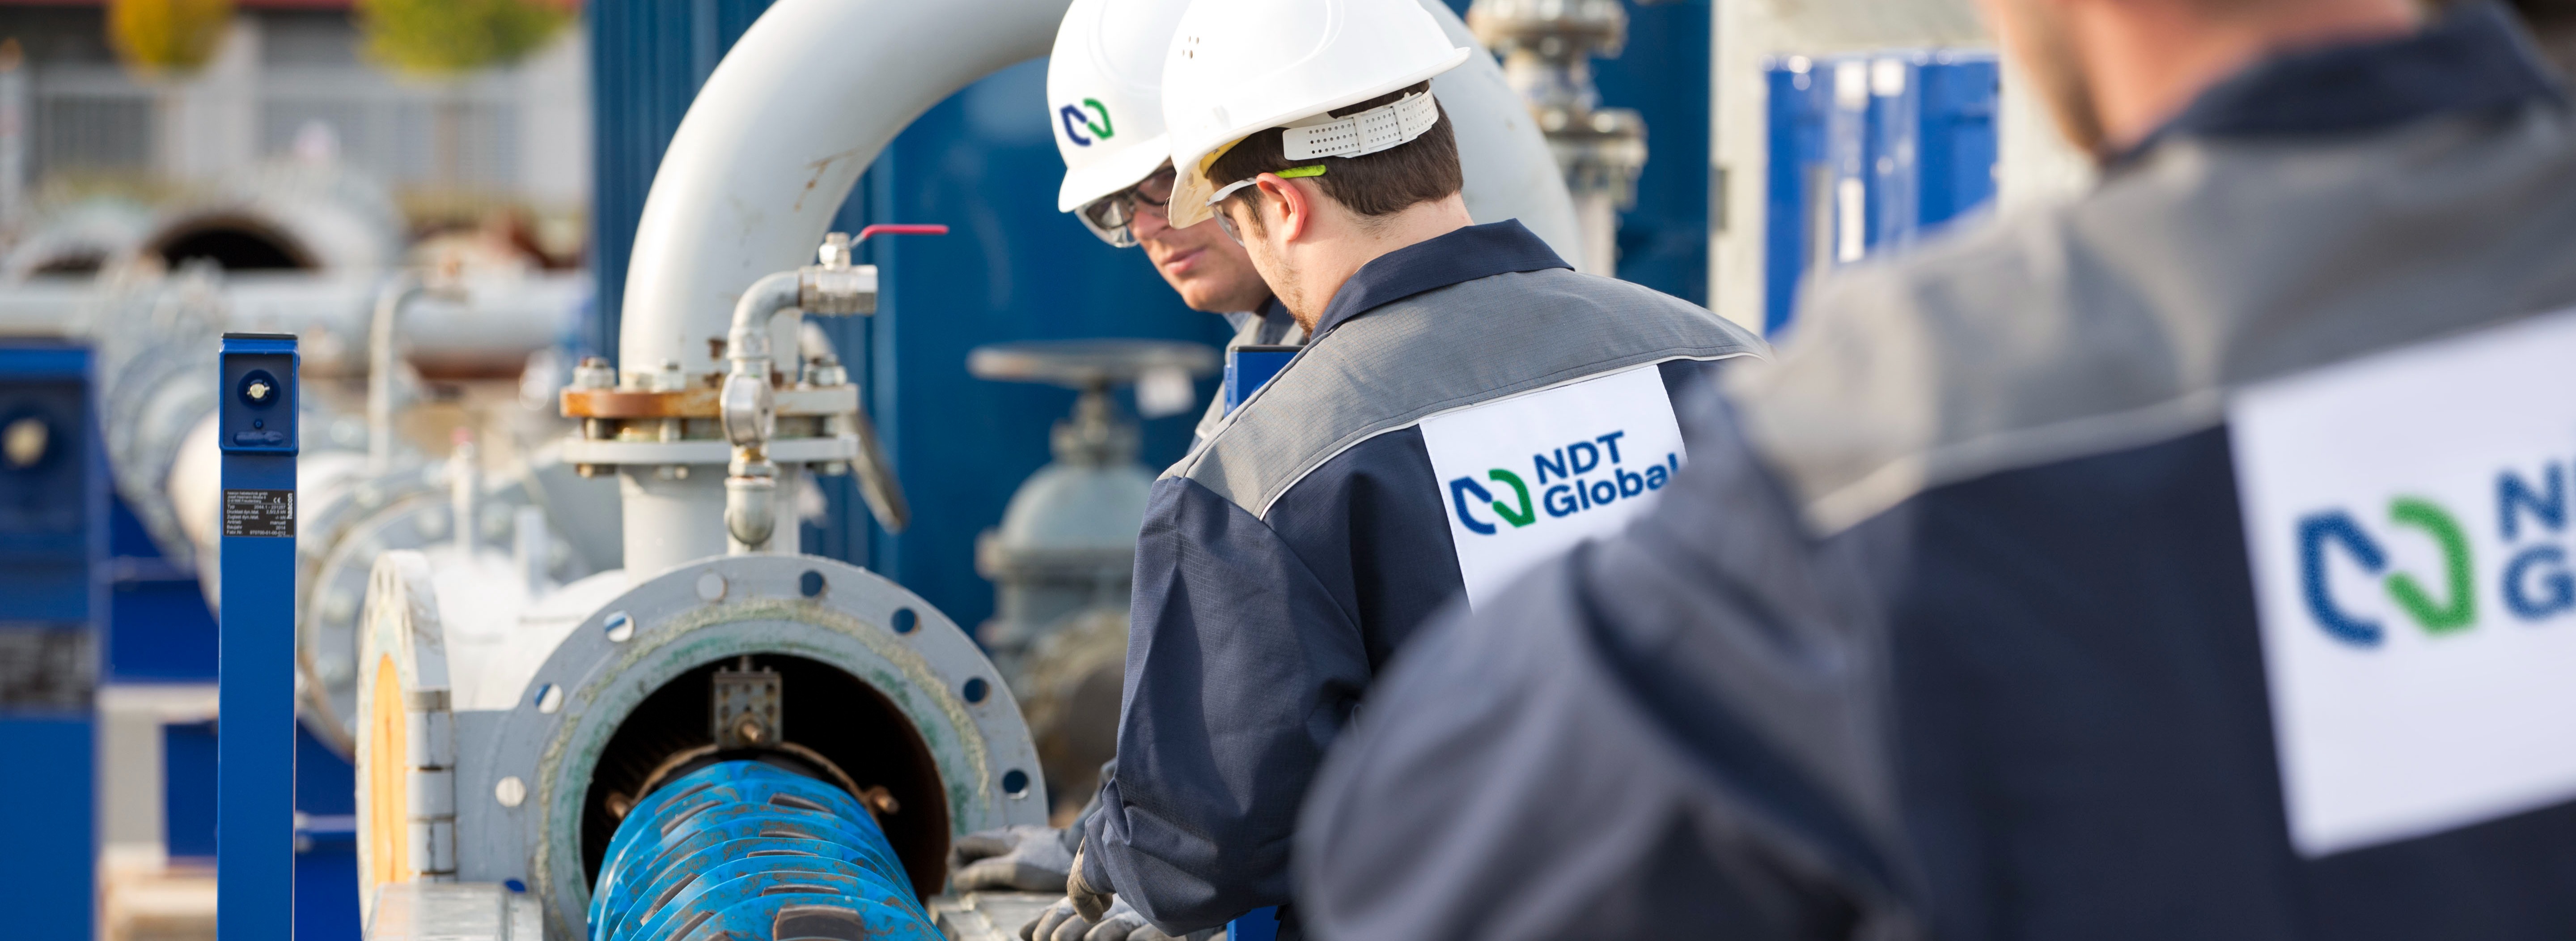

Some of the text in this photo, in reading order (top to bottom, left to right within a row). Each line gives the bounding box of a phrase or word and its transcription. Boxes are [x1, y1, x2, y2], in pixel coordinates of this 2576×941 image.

[1533, 430, 1624, 485] NDT
[1543, 452, 1678, 518] Global
[2495, 457, 2576, 542] N
